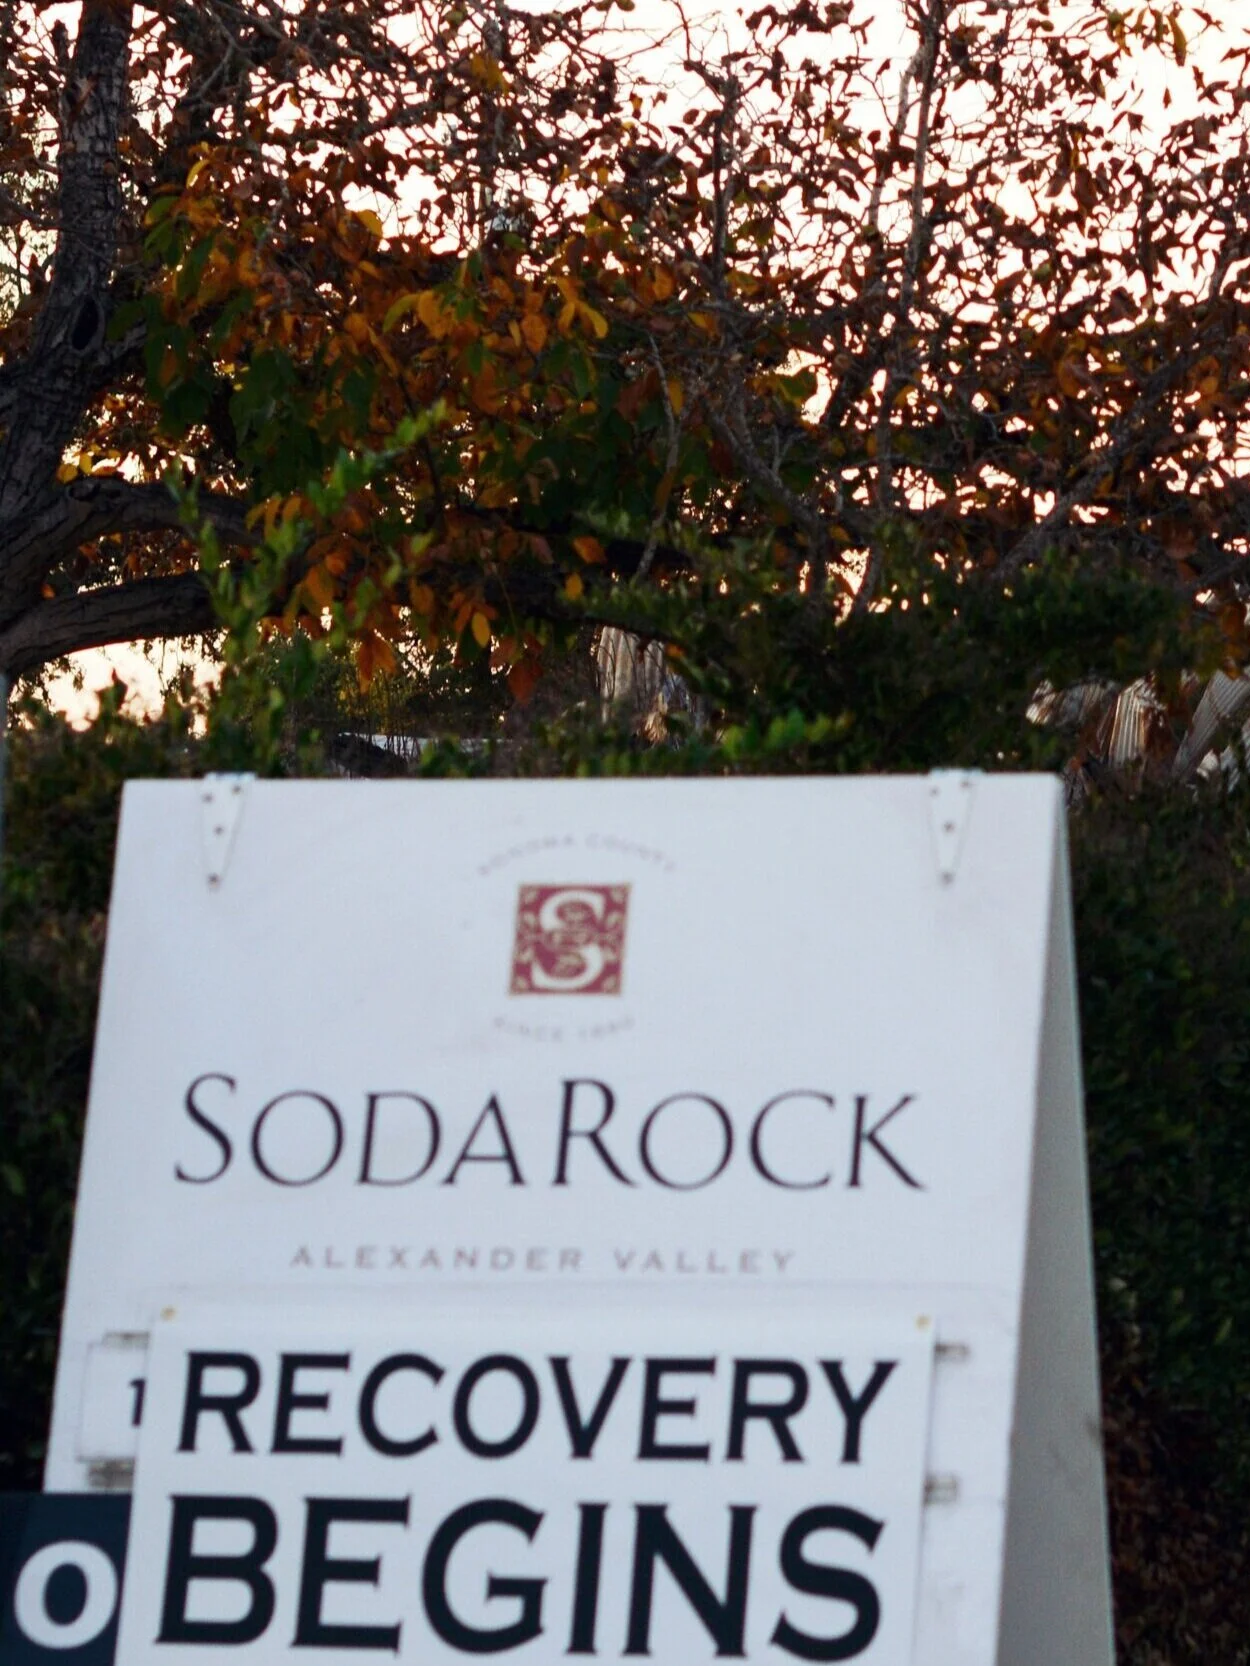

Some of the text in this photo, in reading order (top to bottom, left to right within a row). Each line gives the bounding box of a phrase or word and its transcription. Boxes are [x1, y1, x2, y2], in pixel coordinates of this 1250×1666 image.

[289, 1245, 796, 1274] ALEXANDER VALLEY
[177, 1350, 898, 1465] RECOVERY
[153, 1492, 886, 1665] BEGINS
